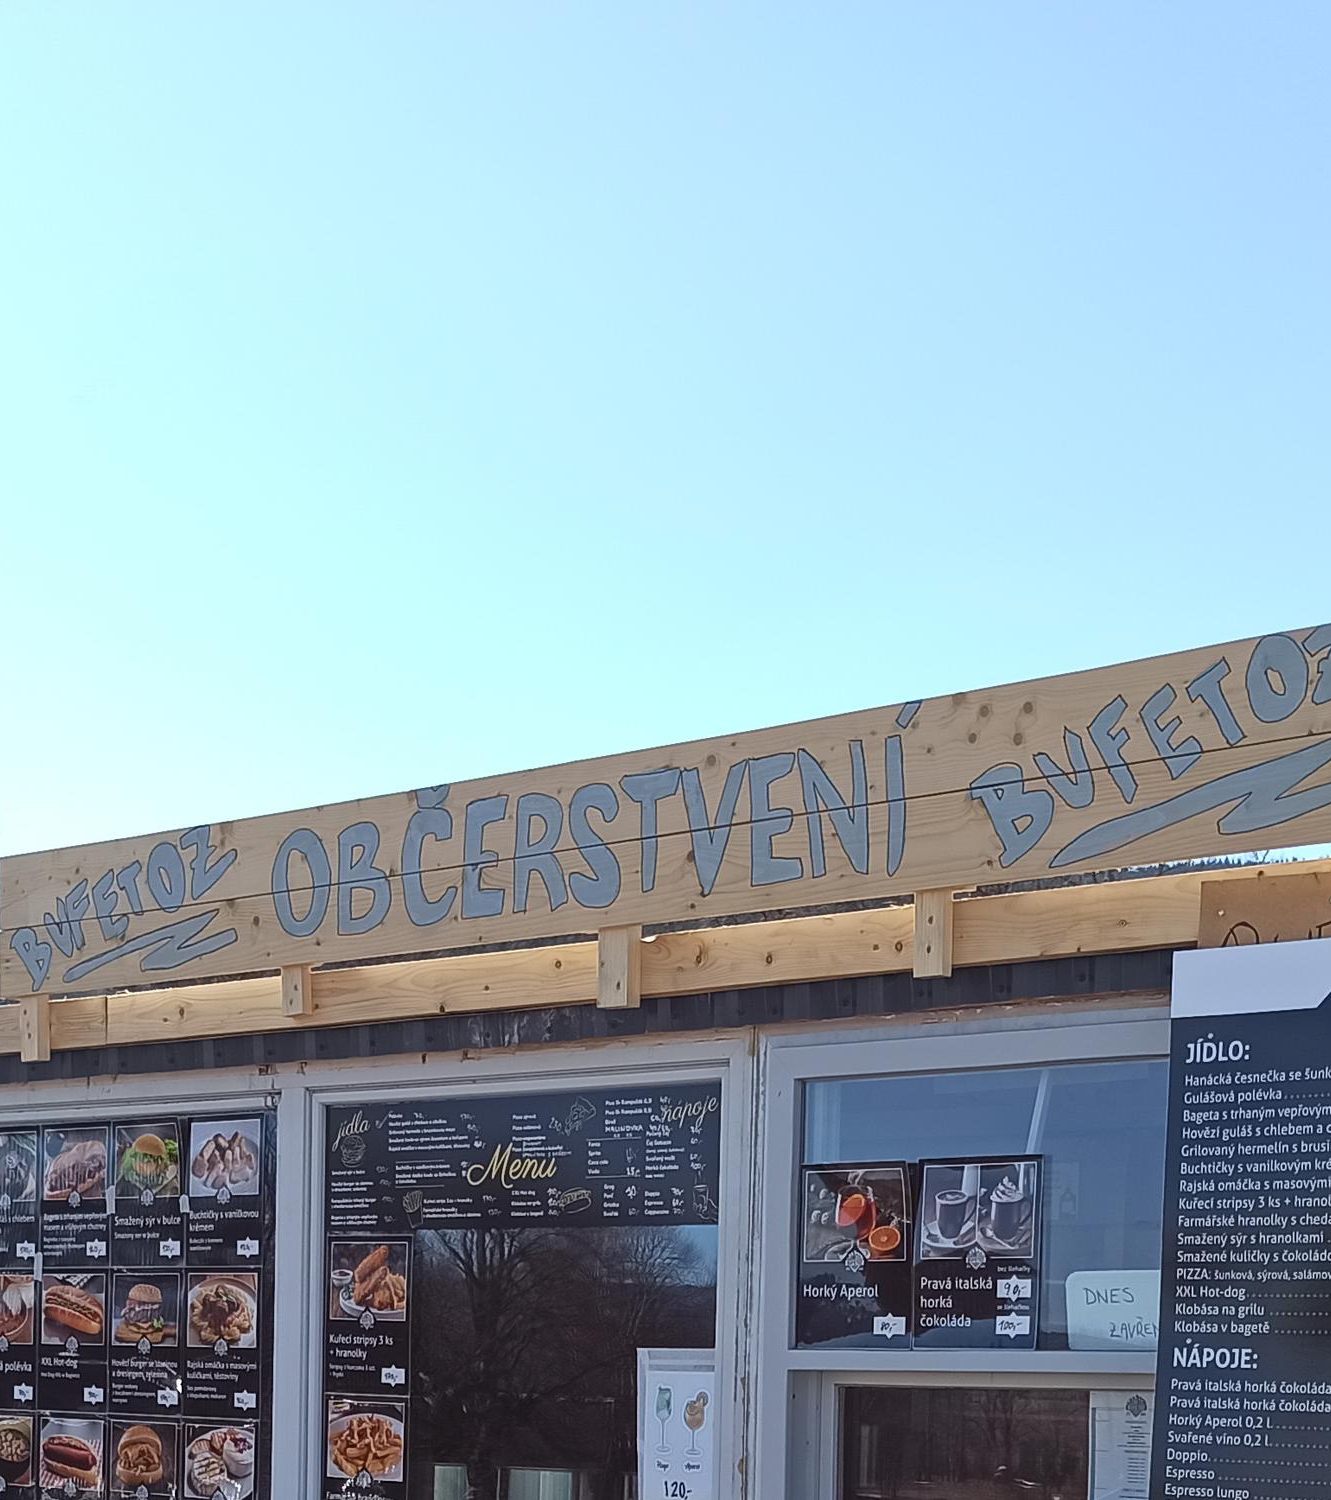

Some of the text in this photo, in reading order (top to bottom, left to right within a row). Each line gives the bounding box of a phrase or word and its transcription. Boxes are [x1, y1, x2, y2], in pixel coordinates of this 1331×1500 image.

[272, 701, 922, 937] OBČERSTVENÍ
[10, 825, 237, 991] BUFETOZ
[1185, 1039, 1250, 1064] JÍDLO:
[1185, 1072, 1232, 1086] Hanácká
[1234, 1069, 1285, 1083] česnečka
[1288, 1071, 1302, 1080] se
[1184, 1088, 1282, 1104] Gulášová polévka
[664, 1096, 718, 1129] nápoje
[1183, 1109, 1219, 1124] Bageta
[1222, 1110, 1227, 1120] s
[1230, 1106, 1275, 1121] trhaným
[1277, 1103, 1331, 1119] vepřovým
[332, 1110, 370, 1153] jídla
[1182, 1126, 1220, 1139] Hovězí
[1222, 1124, 1252, 1141] guláš
[1255, 1126, 1261, 1136] s
[1263, 1123, 1313, 1136] chlebem
[1316, 1124, 1323, 1133] a
[1181, 1144, 1235, 1158] Grilovaný
[1237, 1141, 1289, 1154] hermelín
[1292, 1143, 1298, 1153] s
[467, 1143, 556, 1190] Menu
[1180, 1161, 1235, 1176] Buchtičky
[1237, 1163, 1243, 1172] s
[1245, 1159, 1311, 1174] vanilkovým
[1178, 1197, 1214, 1209] Kuřecí
[1216, 1196, 1255, 1211] stripsy
[1258, 1195, 1265, 1208] 3
[1268, 1195, 1281, 1207] ks
[1284, 1197, 1291, 1205] +
[114, 1216, 144, 1227] Smažený
[145, 1216, 155, 1227] sýr
[163, 1214, 181, 1225] bulce
[1178, 1214, 1235, 1227] Farmářské
[1237, 1213, 1288, 1228] hranolky
[1290, 1215, 1297, 1225] s
[920, 1275, 994, 1291] Pravá italská
[804, 1284, 880, 1300] Horký Aperol
[1083, 1287, 1135, 1305] DNES
[1175, 1285, 1246, 1301] XXL Hot-dog
[920, 1294, 953, 1310] horká
[1175, 1302, 1264, 1318] Klobása na grilu
[920, 1312, 972, 1329] čokoláda
[1174, 1320, 1270, 1336] Klobása v bagetě
[329, 1334, 351, 1344] Kuřecí
[353, 1335, 377, 1348] stripsy
[385, 1335, 394, 1346] ks
[335, 1347, 367, 1360] hranolky
[1172, 1343, 1259, 1370] NÁPOJE:
[4, 1361, 33, 1374] polévka
[1171, 1378, 1201, 1390] Pravá
[1204, 1379, 1241, 1392] italská
[1244, 1380, 1277, 1393] horká
[1279, 1381, 1331, 1394] čokoláda
[1166, 1448, 1208, 1463] Doppio
[1166, 1465, 1215, 1480] Espresso
[664, 1481, 692, 1500] 120,-
[1164, 1483, 1214, 1497] Espresso
